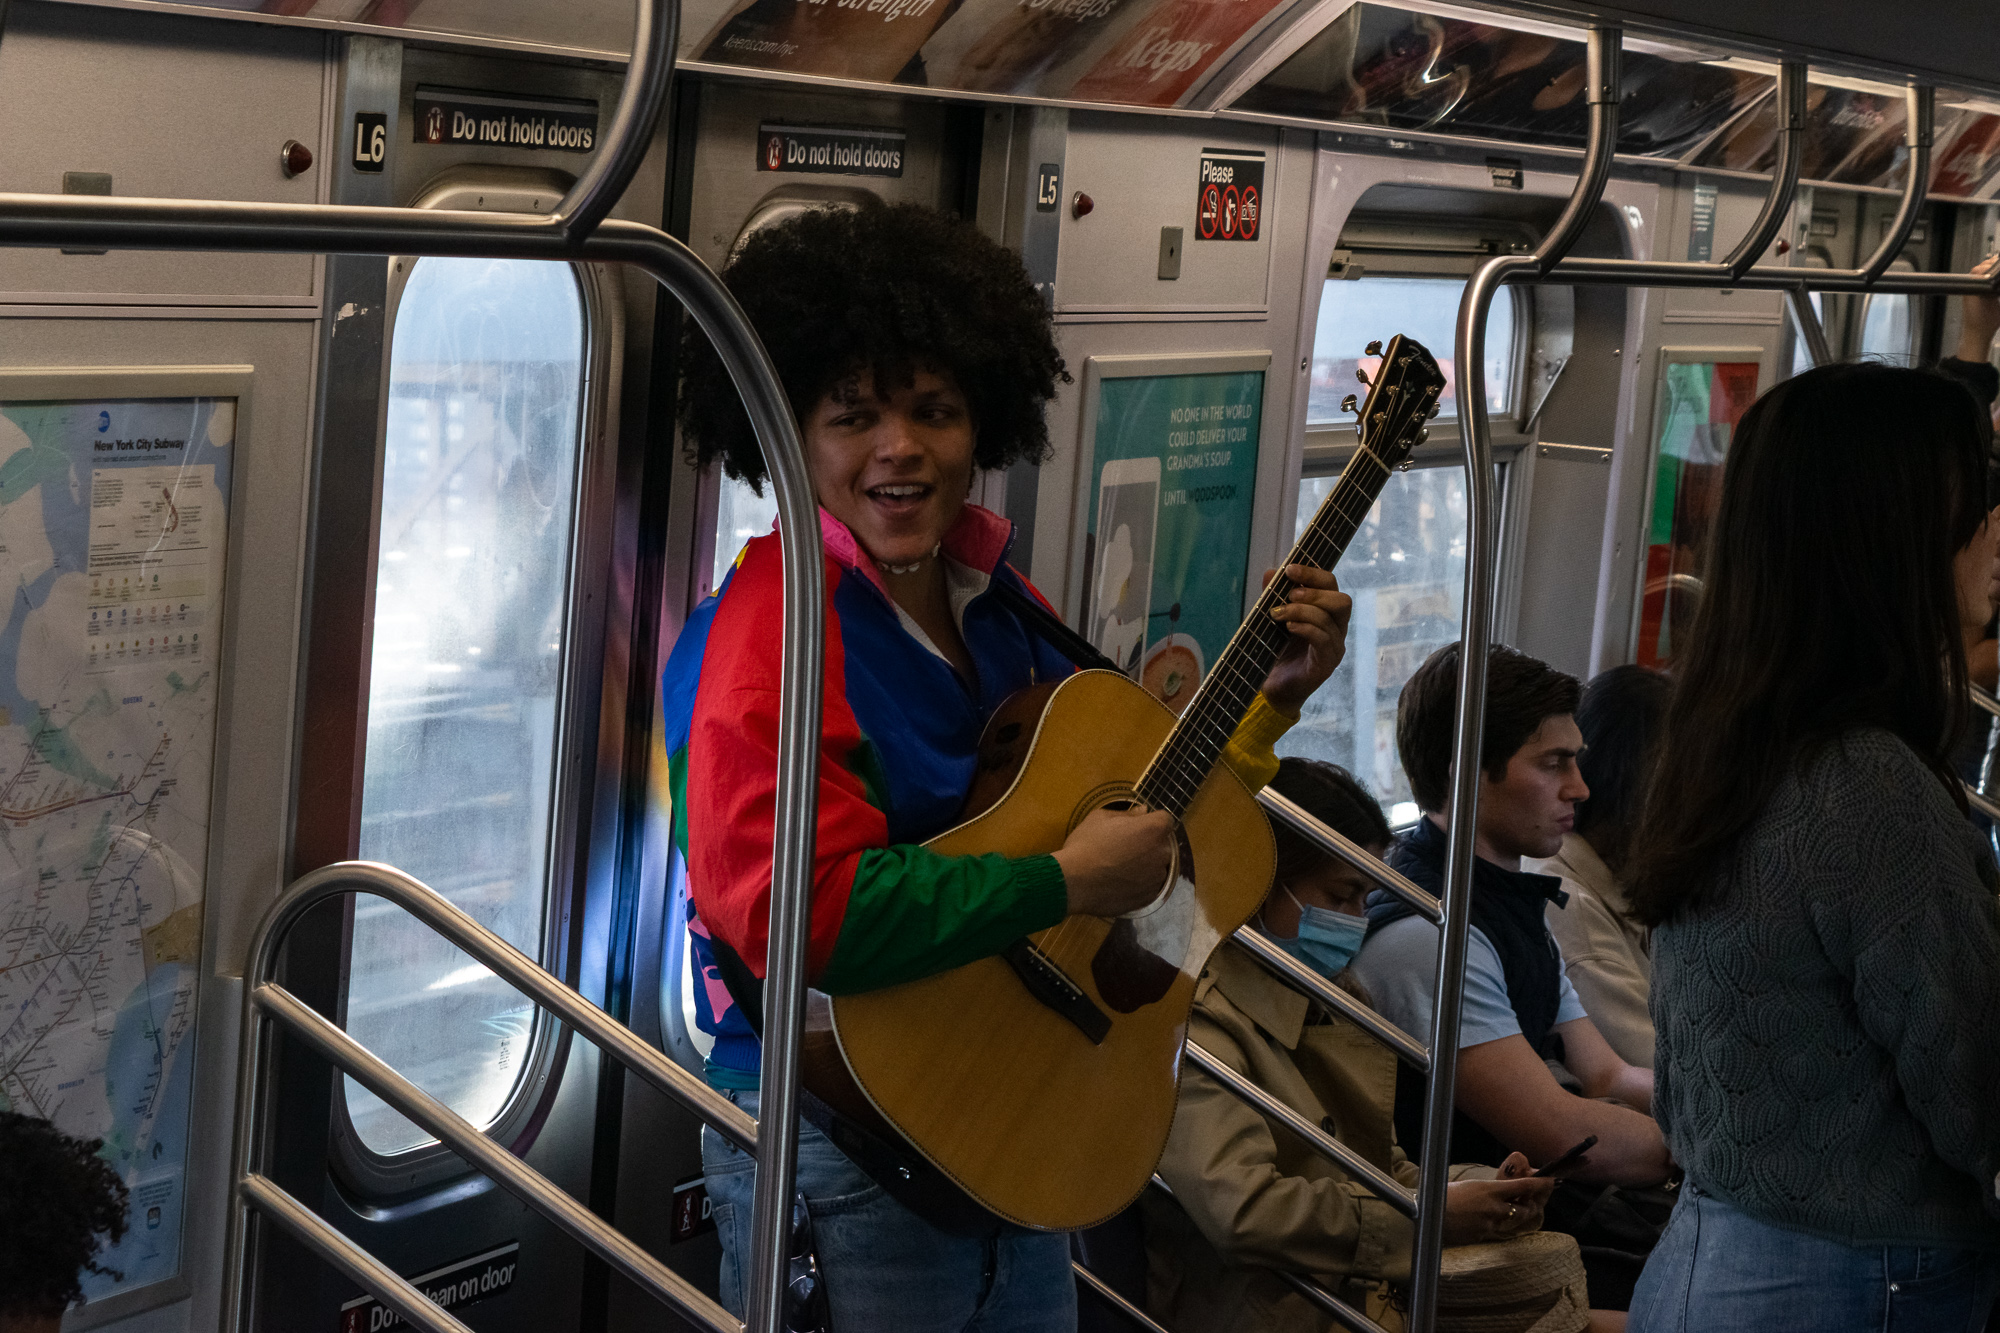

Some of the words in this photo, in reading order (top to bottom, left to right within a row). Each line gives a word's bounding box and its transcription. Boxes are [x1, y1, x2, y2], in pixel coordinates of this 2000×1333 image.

[723, 34, 799, 58] keeps.com/nyc
[1116, 26, 1217, 83] Keeps
[453, 111, 476, 140] Do
[480, 117, 506, 143] not
[510, 116, 545, 145] hold
[548, 120, 592, 149] doors
[356, 123, 386, 163] L6
[787, 139, 806, 164] Do
[809, 143, 831, 165] not
[833, 142, 862, 167] hold
[865, 144, 901, 169] doors
[1202, 160, 1234, 184] Please
[1038, 174, 1057, 205] L5
[1170, 408, 1183, 424] NO
[1184, 406, 1200, 422] ONE
[1201, 406, 1209, 421] IN
[1210, 405, 1224, 420] THE
[1225, 404, 1252, 419] WORLD
[94, 440, 114, 451] New
[116, 439, 134, 451] York
[136, 439, 152, 452] City
[154, 438, 185, 450] Subway
[1169, 431, 1195, 447] COULD
[1196, 428, 1226, 445] DELIVER
[1227, 427, 1247, 442] YOUR
[1167, 452, 1210, 471] GRANDMA'S
[1164, 489, 1187, 506] UNTIL
[702, 1196, 712, 1220] D
[370, 1305, 394, 1333] Do
[459, 1277, 478, 1300] on
[480, 1263, 516, 1292] door
